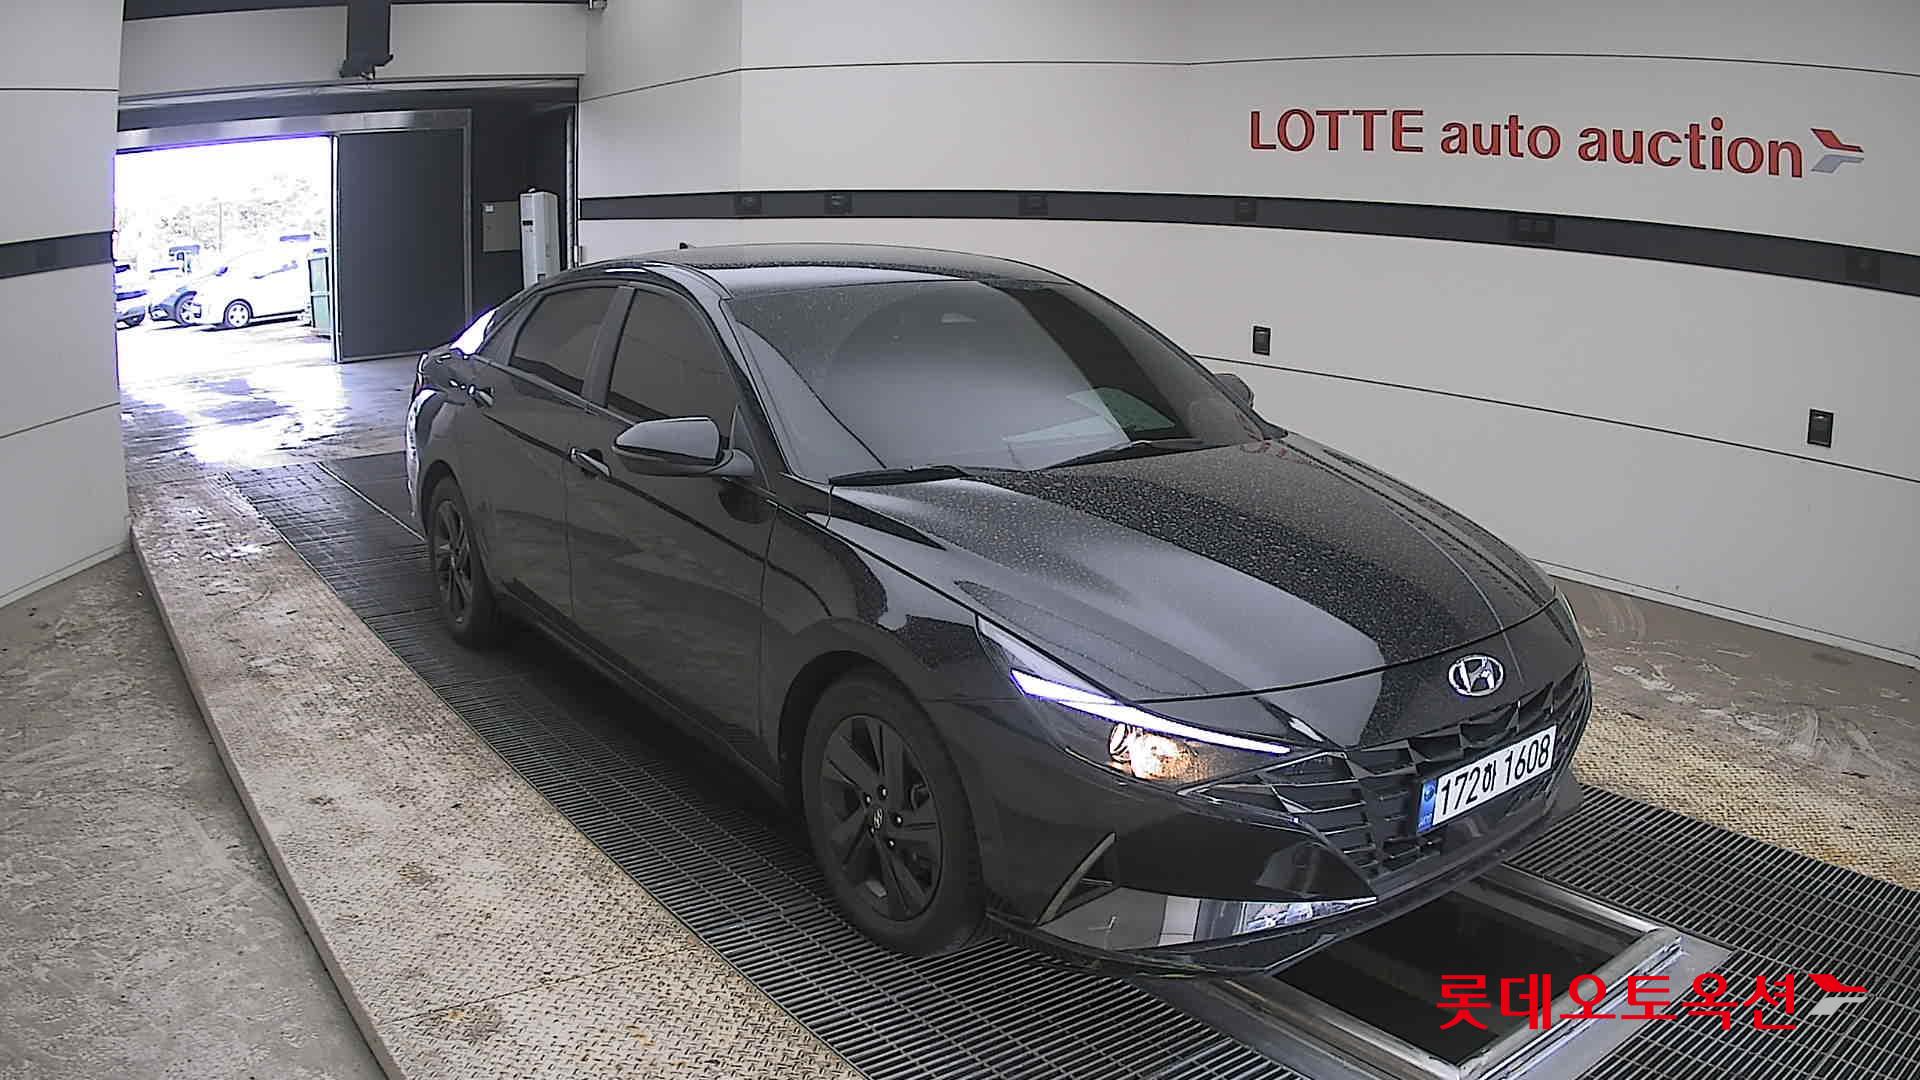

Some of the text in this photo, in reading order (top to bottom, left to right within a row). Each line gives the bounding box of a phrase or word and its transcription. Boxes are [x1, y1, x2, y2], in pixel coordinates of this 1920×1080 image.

[1249, 109, 1803, 178] LOTTE auto auction
[1441, 734, 1551, 815] 172하 1608
